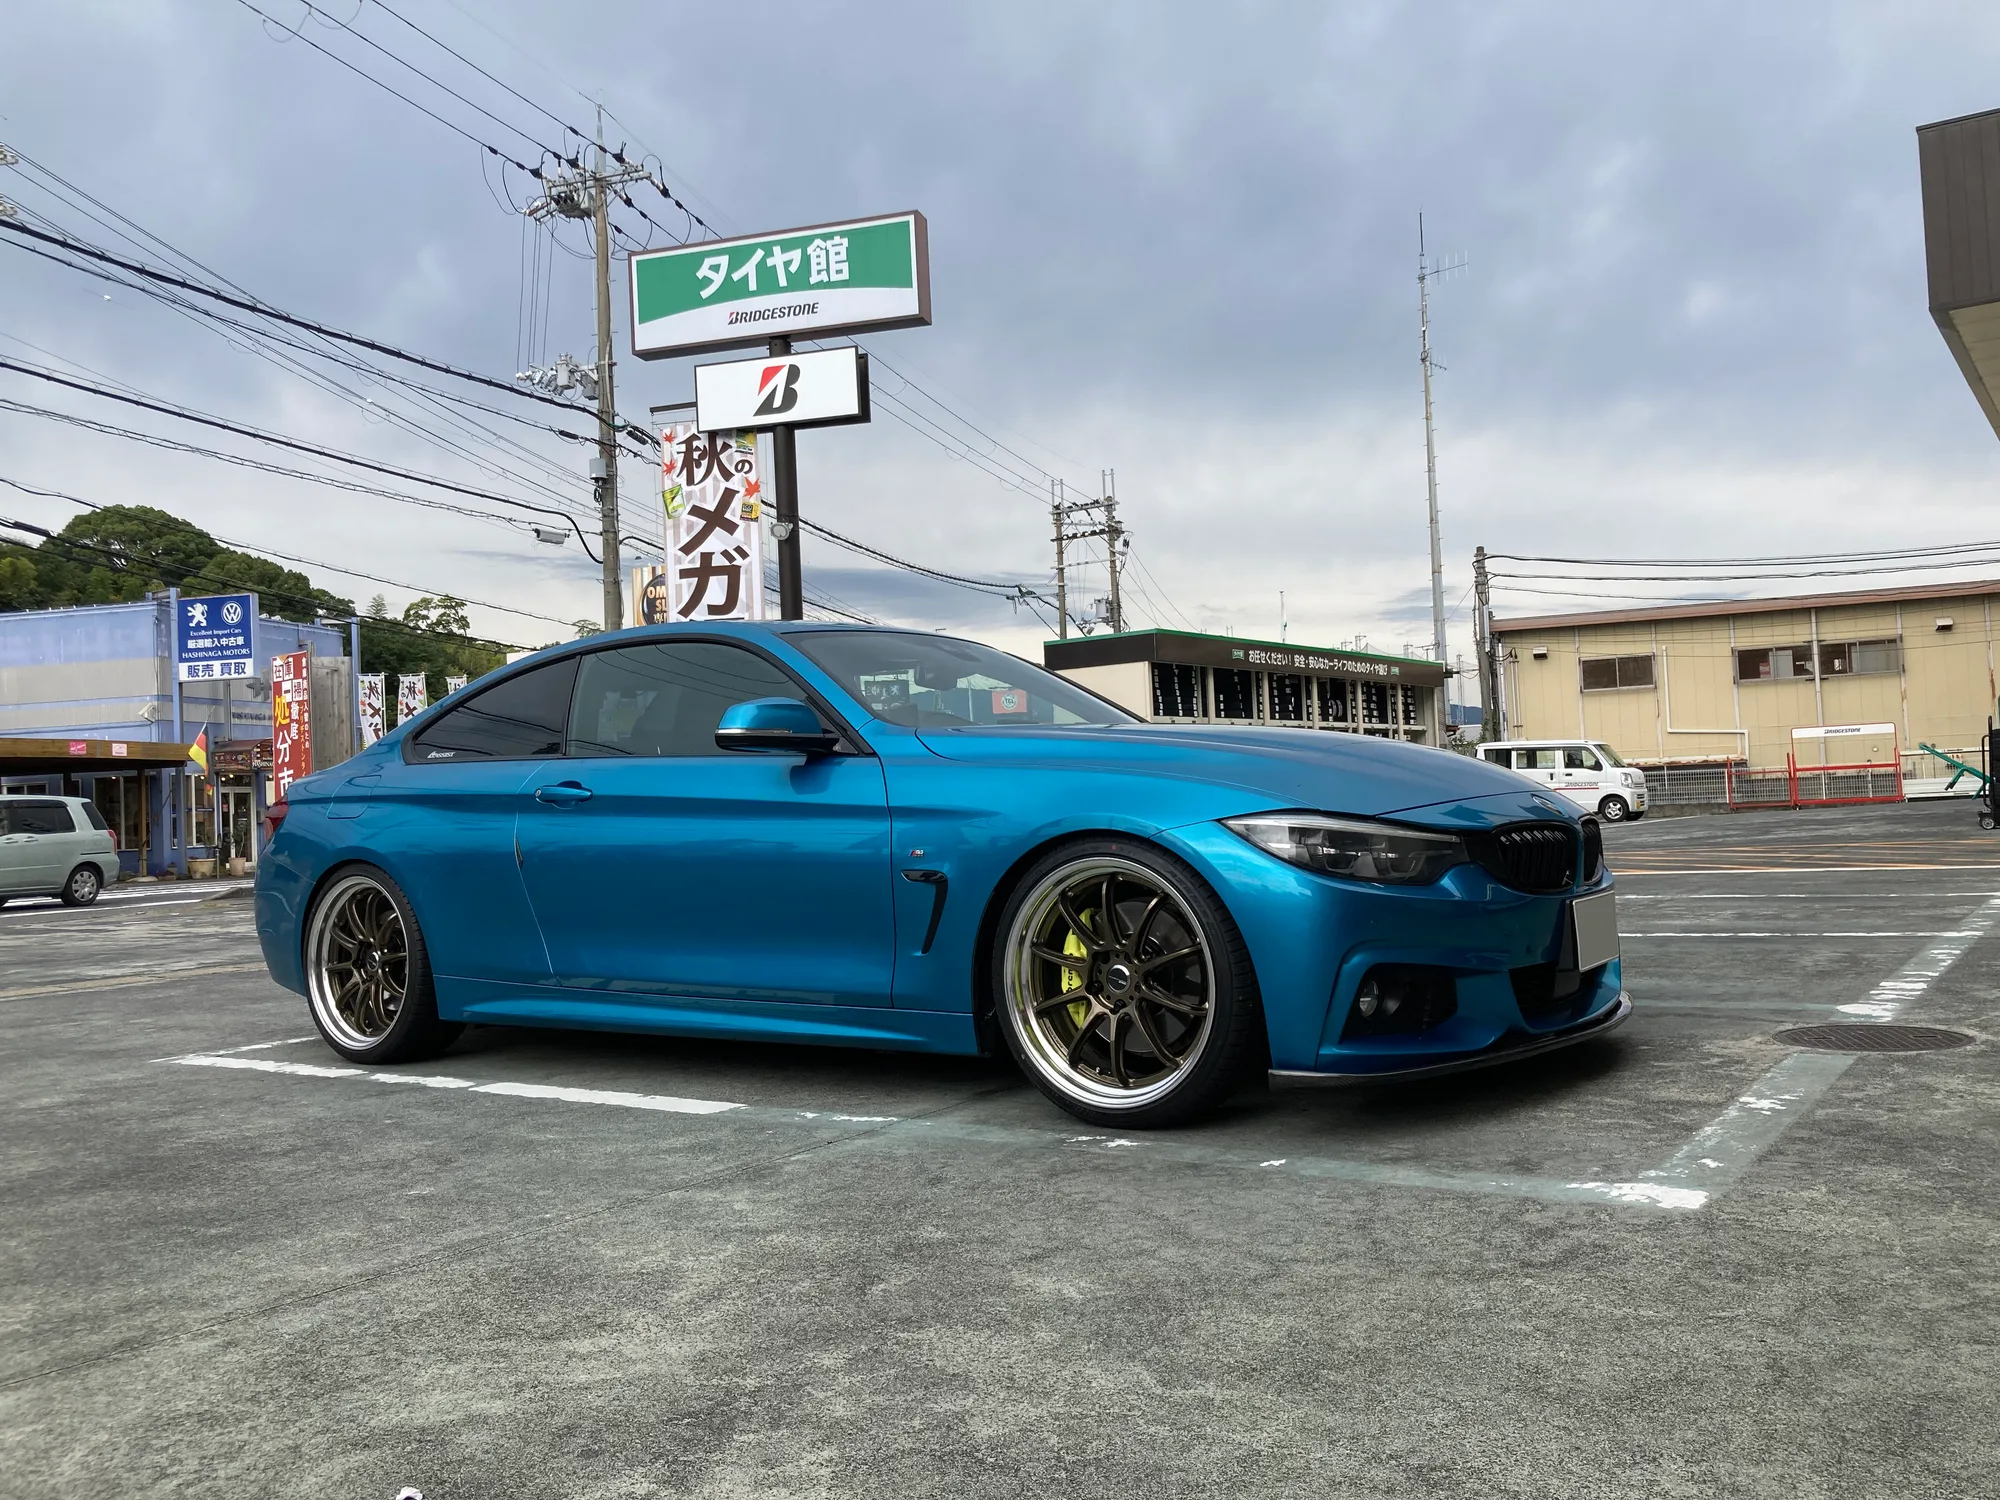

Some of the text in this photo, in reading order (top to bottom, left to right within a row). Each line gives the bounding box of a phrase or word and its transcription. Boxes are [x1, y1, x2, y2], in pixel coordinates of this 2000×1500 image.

[695, 235, 850, 300] タイヤ館
[728, 302, 819, 326] BRIDGESTONE
[753, 363, 801, 417] B
[676, 432, 754, 621] 秋のメガ
[190, 629, 213, 637] Excellent
[213, 628, 230, 636] Import
[187, 636, 245, 649] 厳選輸入中古車
[182, 648, 250, 659] HASHINAGA MOTORS
[187, 661, 246, 678] 販売 買取
[1824, 727, 1861, 735] BRIDGESTONE
